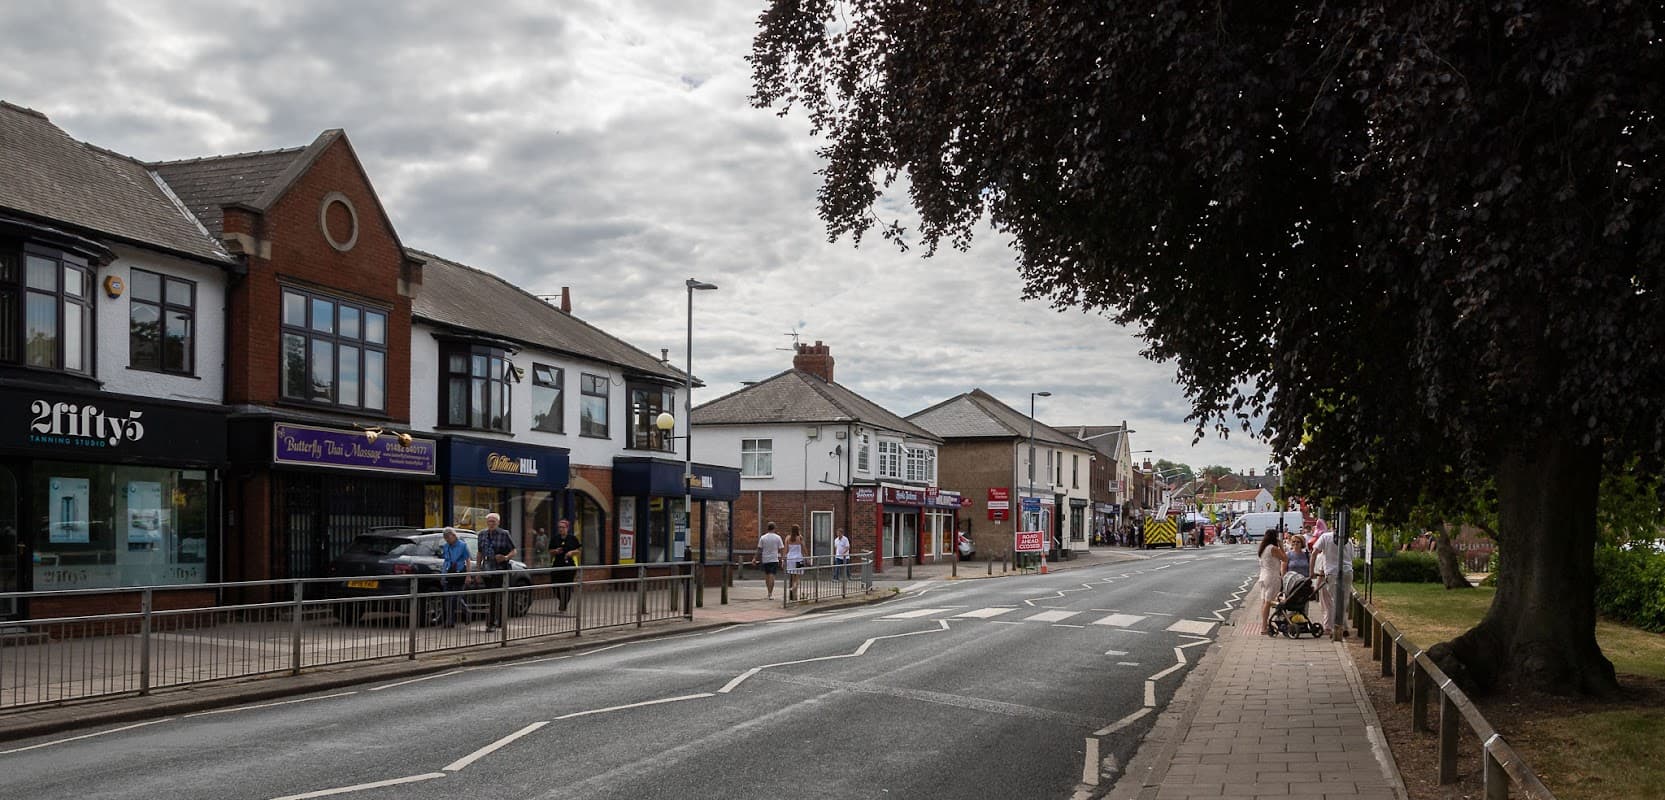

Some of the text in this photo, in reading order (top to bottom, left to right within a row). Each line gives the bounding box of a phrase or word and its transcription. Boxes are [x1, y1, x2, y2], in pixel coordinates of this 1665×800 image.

[31, 399, 144, 447] 2fifty5
[29, 435, 106, 448] TANNING STUDIO
[284, 436, 383, 465] Butterfly Thai Massage
[487, 452, 538, 474] William HILL
